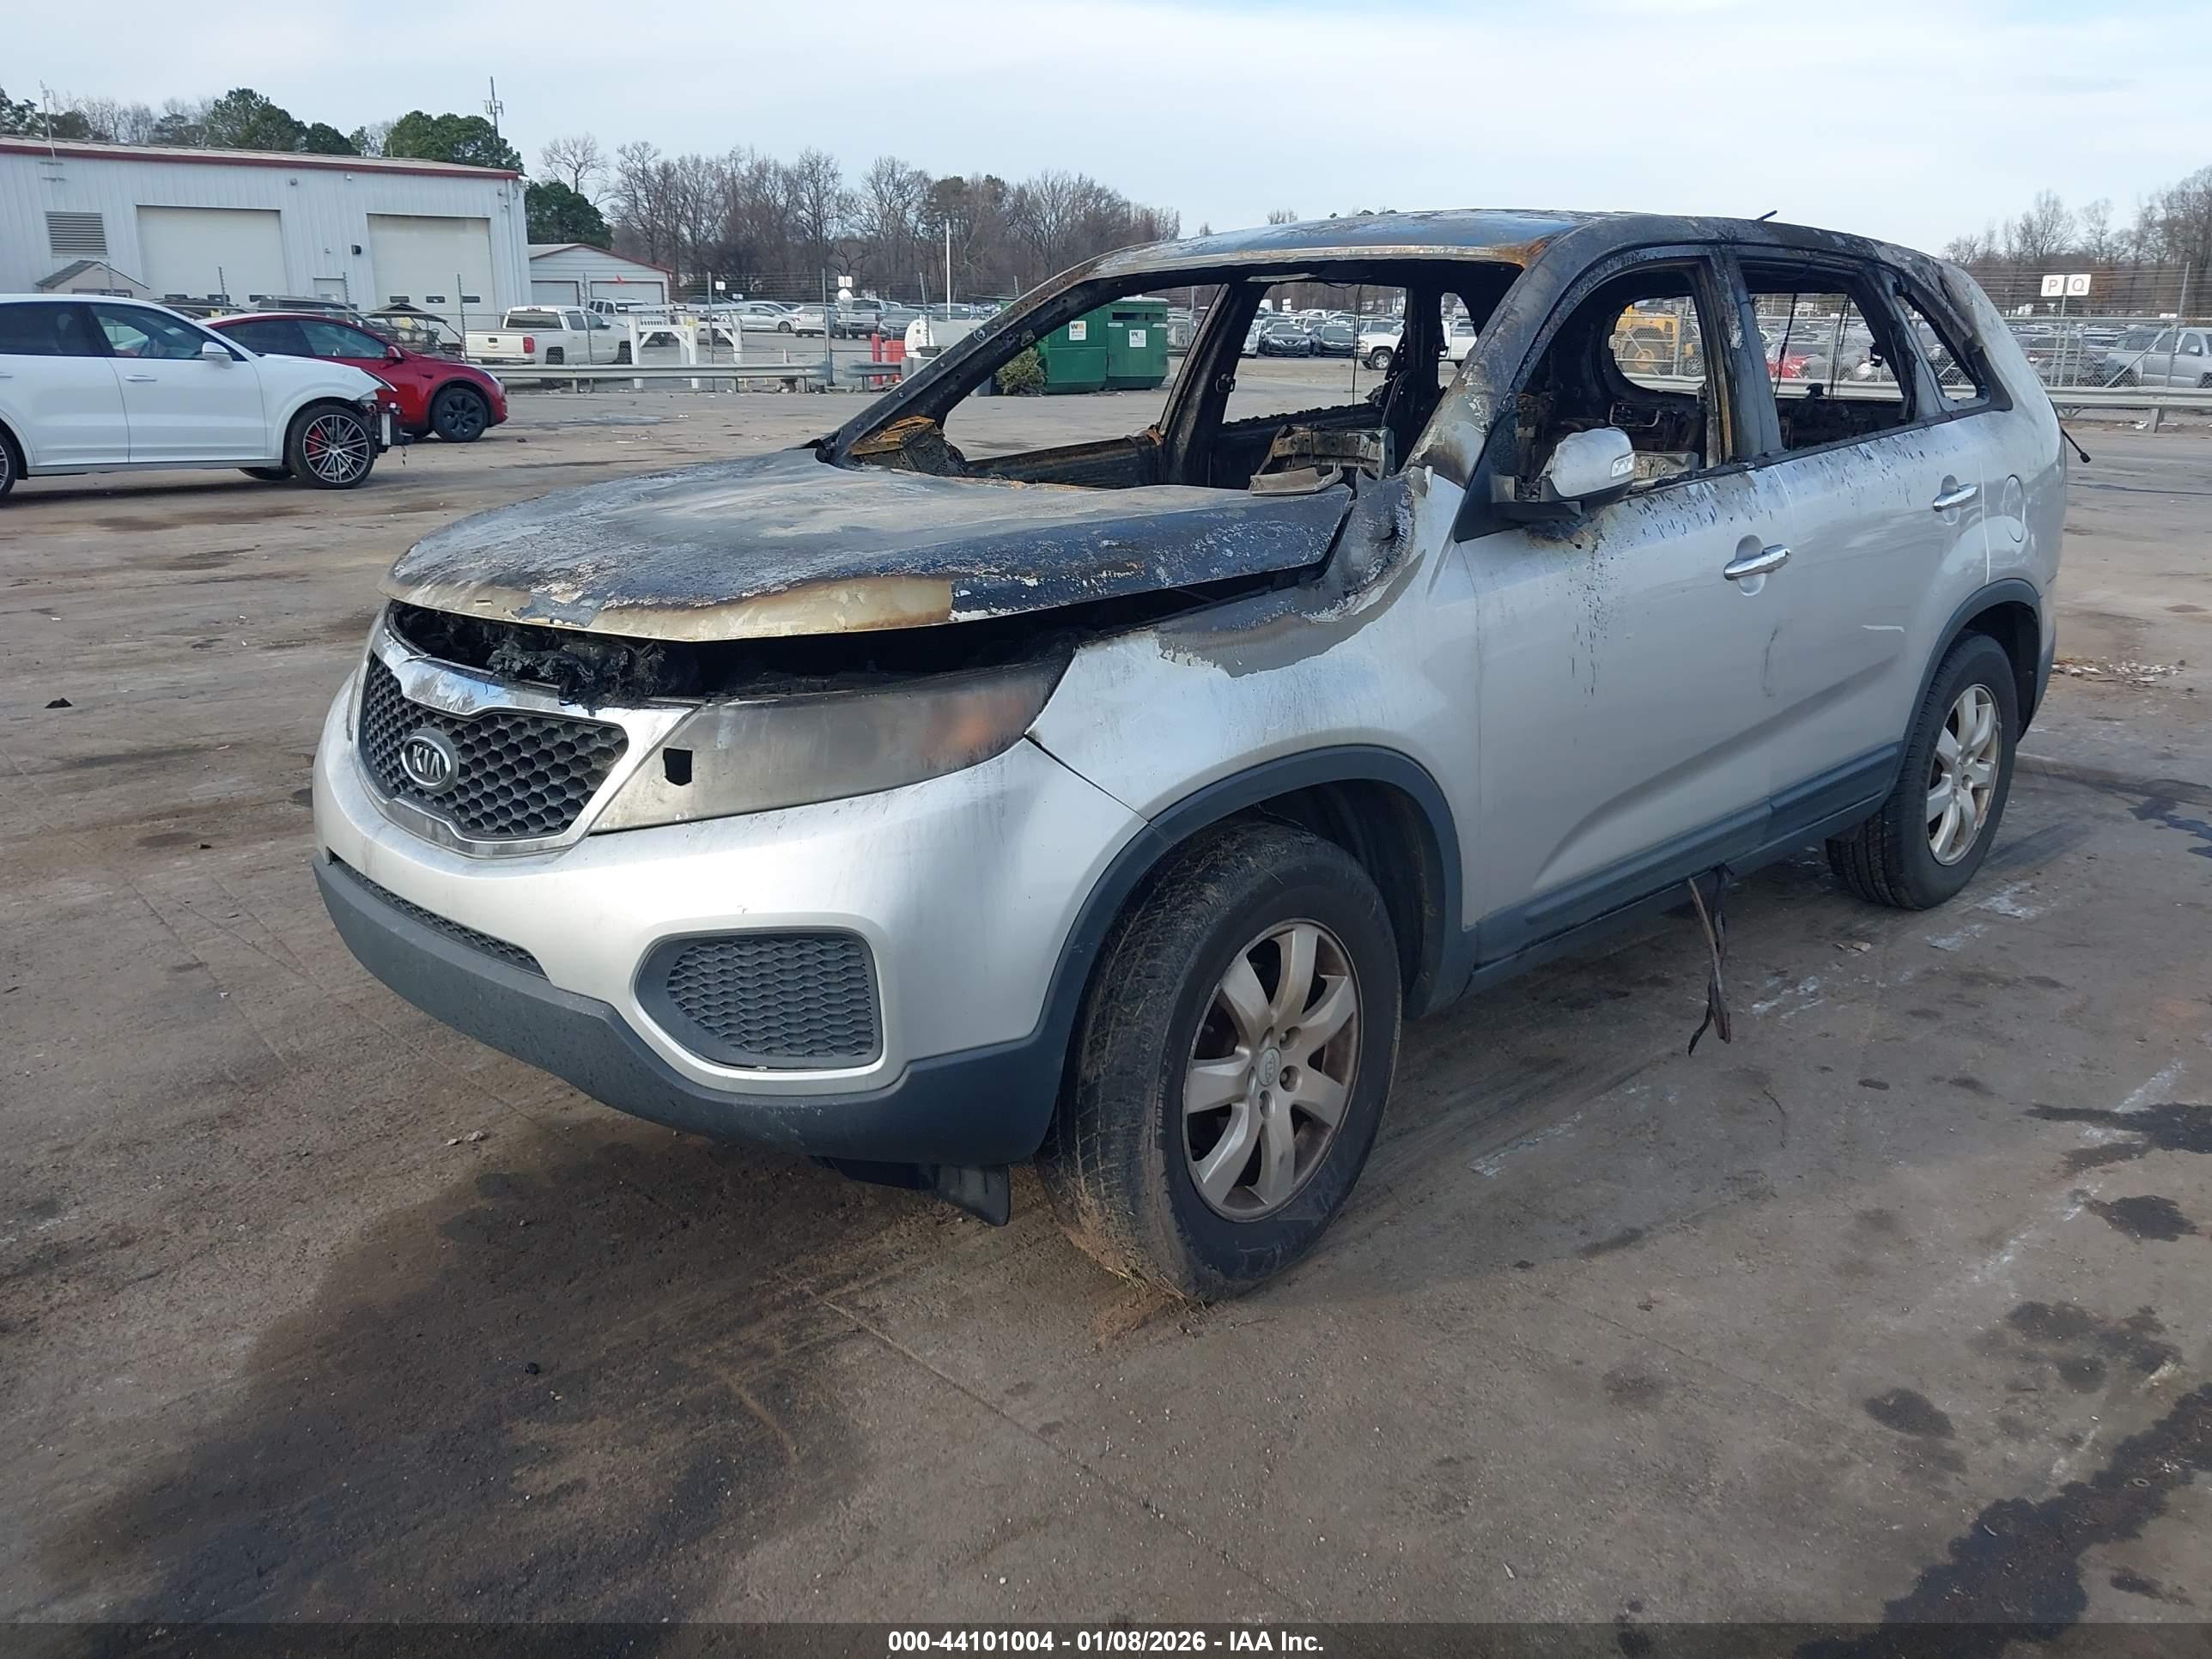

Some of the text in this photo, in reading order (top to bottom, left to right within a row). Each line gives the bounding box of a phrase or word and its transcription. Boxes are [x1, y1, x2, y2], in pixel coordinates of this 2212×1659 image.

[2048, 279, 2058, 292] P
[2072, 278, 2085, 291] Q
[412, 744, 441, 779] KIA
